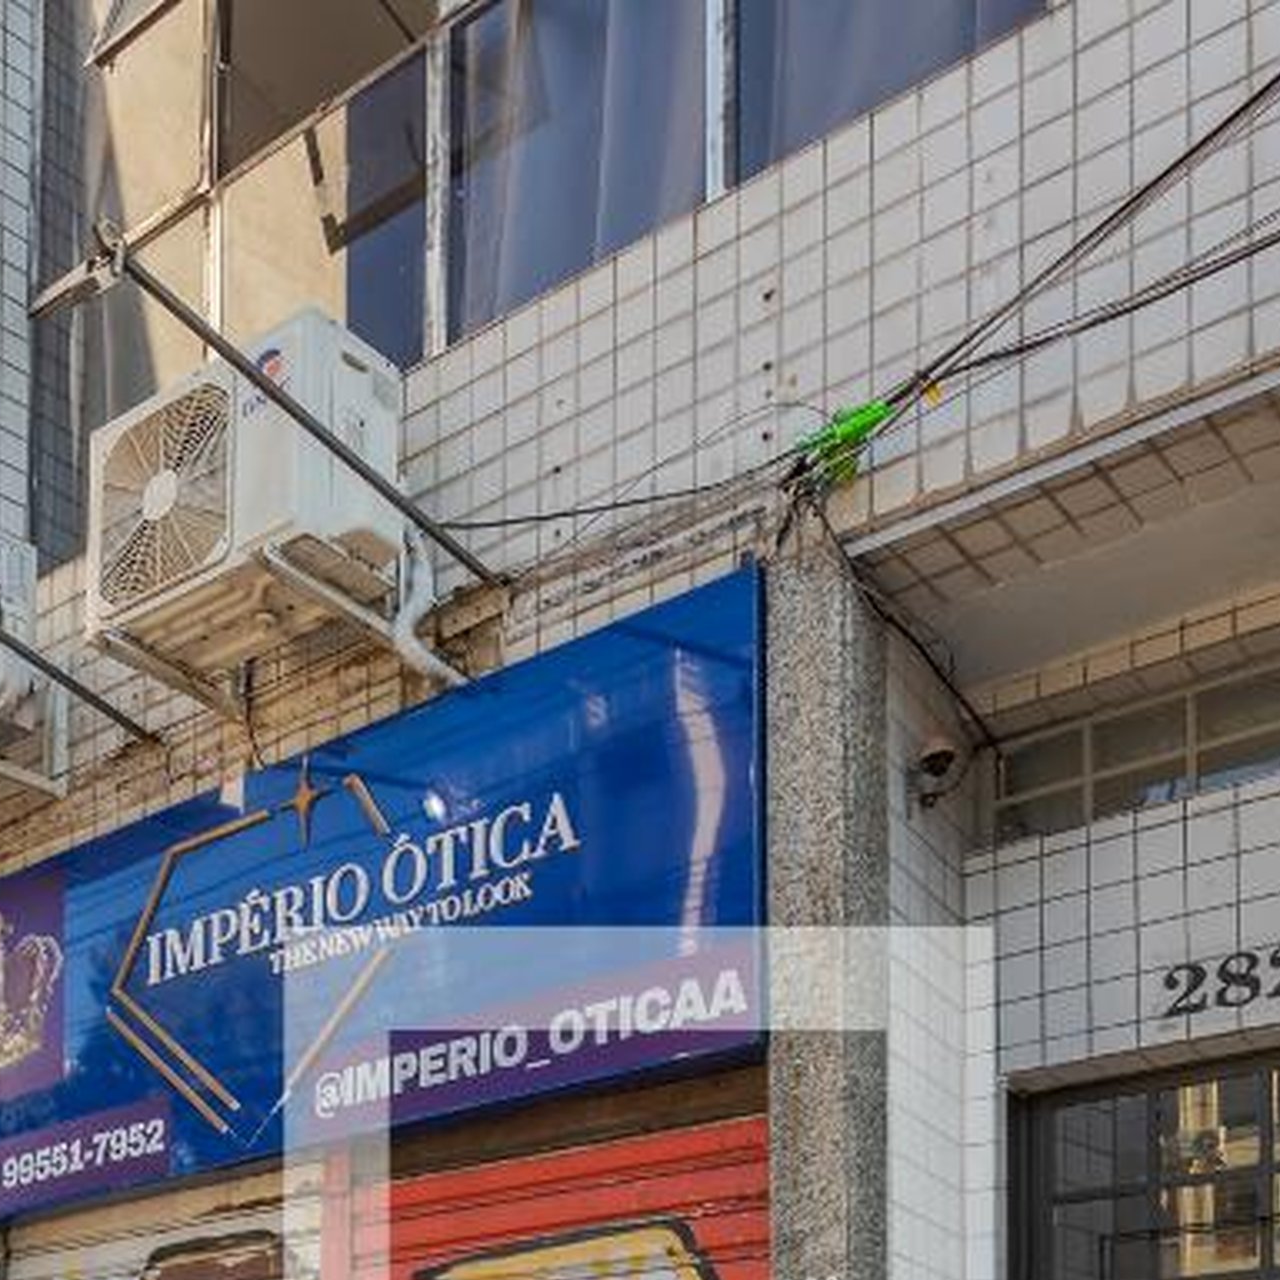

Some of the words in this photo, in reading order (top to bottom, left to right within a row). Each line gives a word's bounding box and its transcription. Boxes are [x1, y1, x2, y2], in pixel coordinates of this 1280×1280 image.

[144, 862, 370, 987] IMPÉRIO
[382, 791, 582, 904] ÓTICA
[463, 873, 534, 916] LOOK
[314, 968, 749, 1118] @IMPERIO_OTICAA
